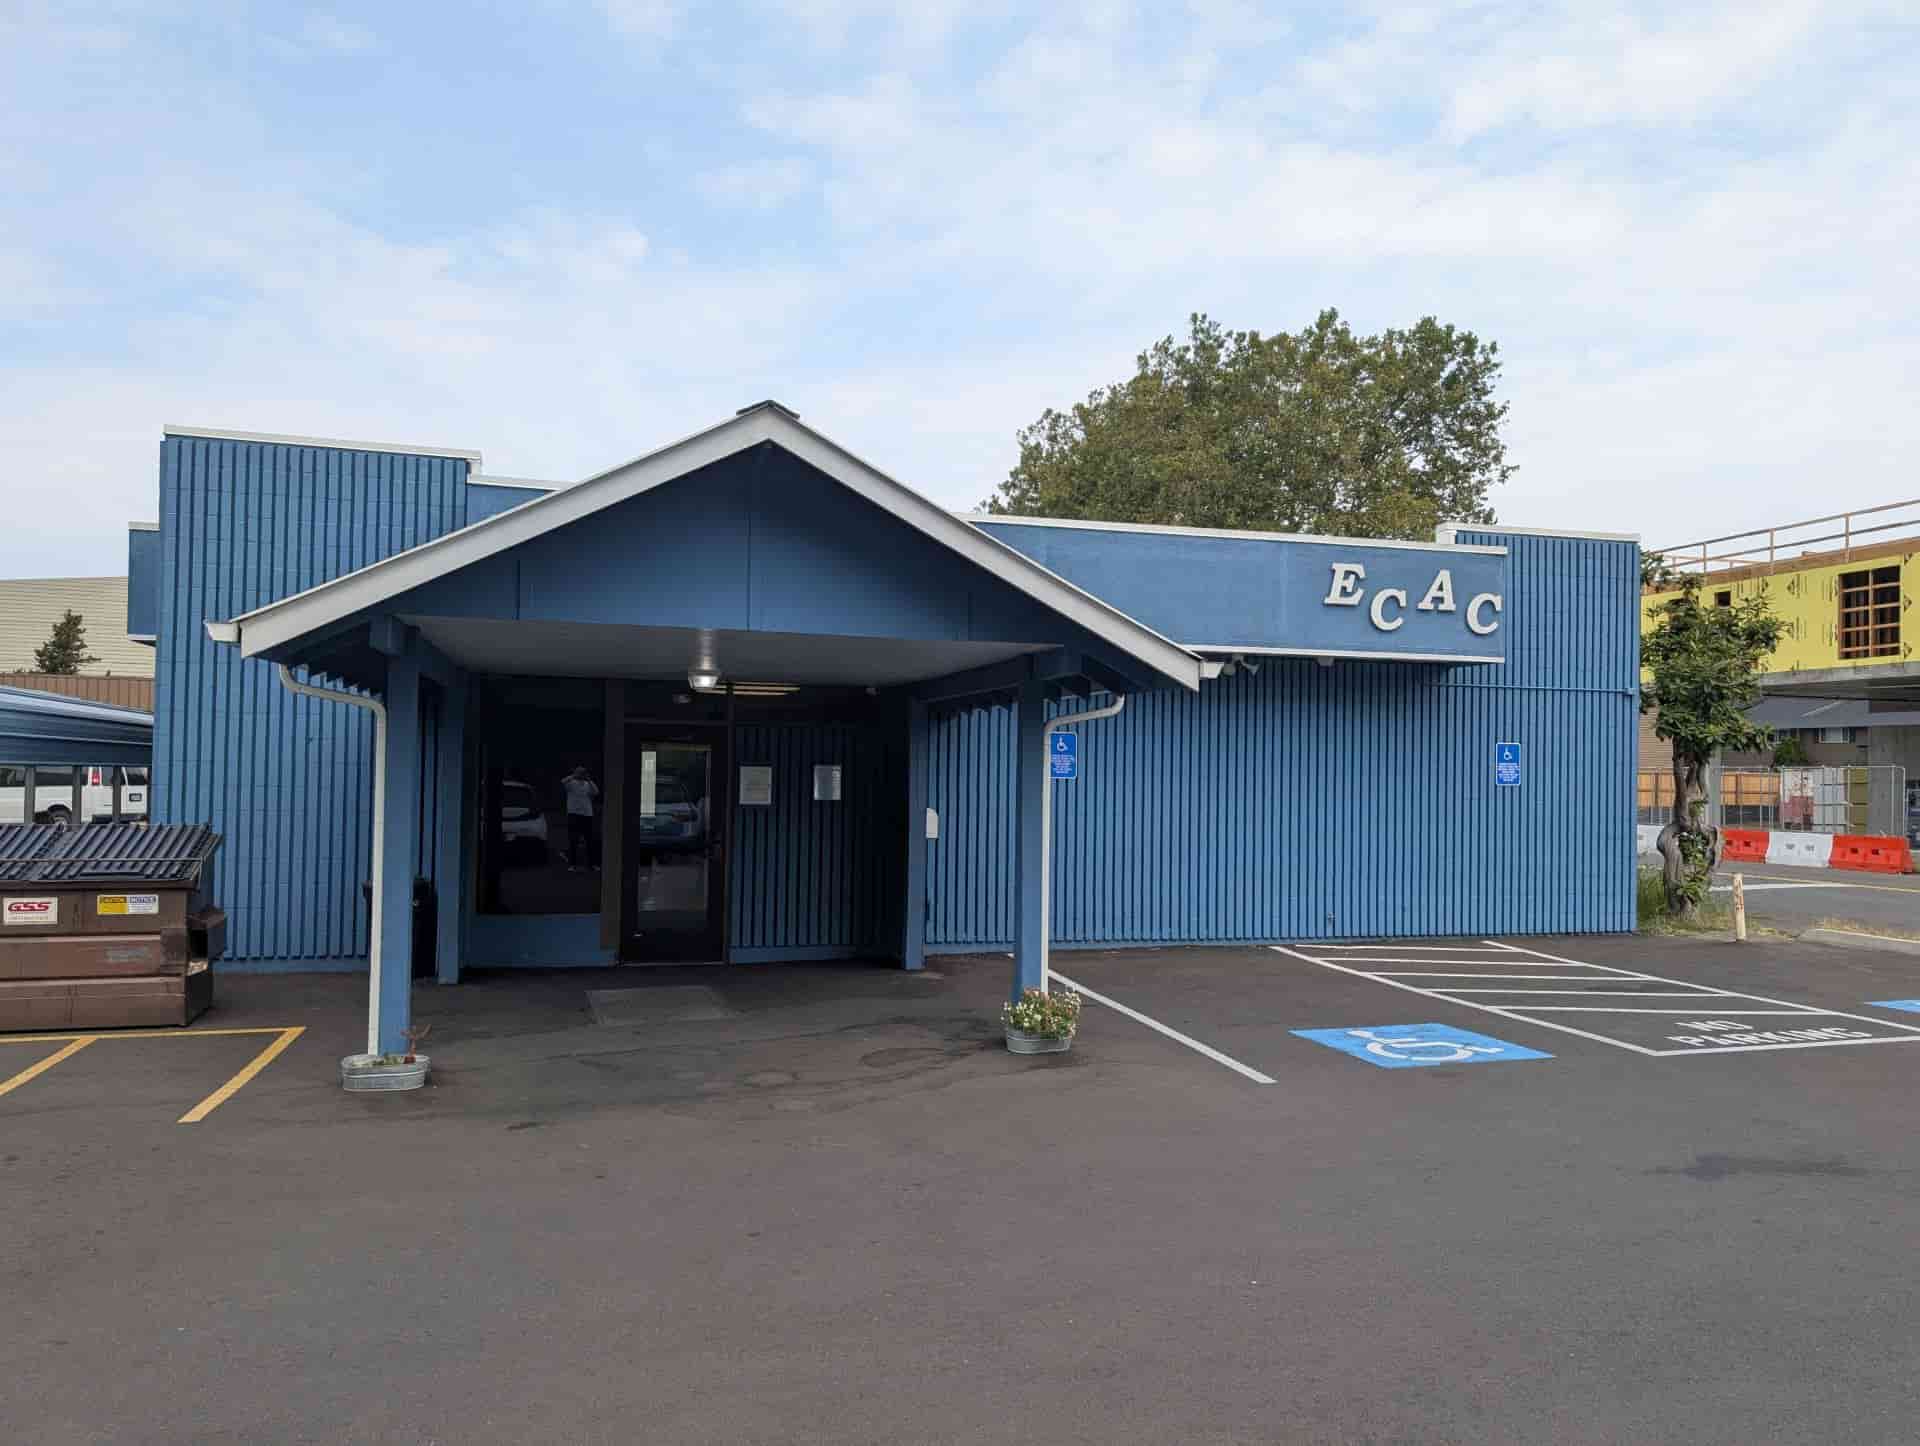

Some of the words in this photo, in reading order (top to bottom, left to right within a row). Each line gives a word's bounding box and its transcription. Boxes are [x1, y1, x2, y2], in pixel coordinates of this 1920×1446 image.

[1324, 562, 1503, 635] ECAC
[1674, 1020, 1753, 1032] NO
[1664, 1028, 1873, 1046] PARKING
